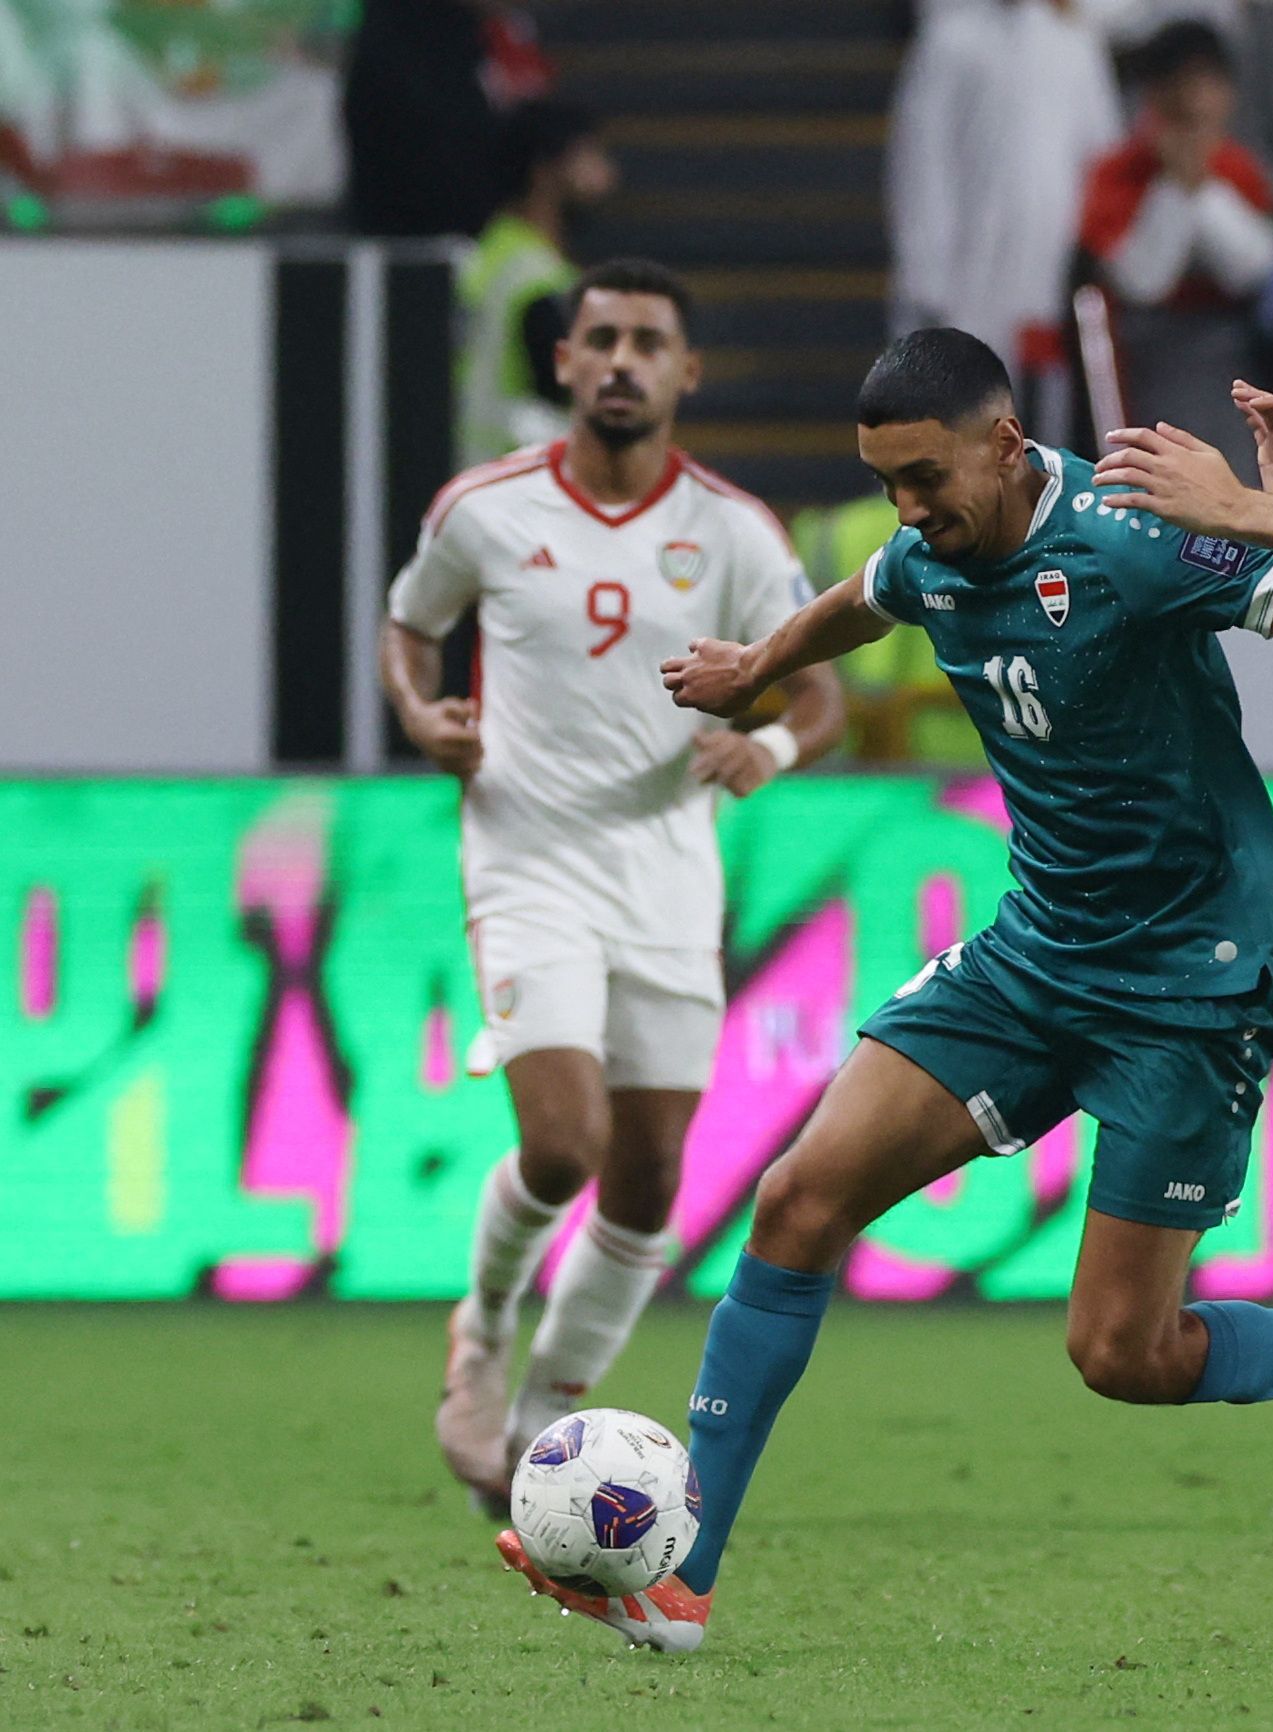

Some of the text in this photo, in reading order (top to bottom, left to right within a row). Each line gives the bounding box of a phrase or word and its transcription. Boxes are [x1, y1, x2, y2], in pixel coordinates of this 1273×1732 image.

[1199, 535, 1218, 560] UNITE
[1039, 572, 1060, 581] IRAQ
[586, 579, 631, 659] 9
[982, 656, 1052, 742] 16
[1163, 1182, 1206, 1202] JAKO
